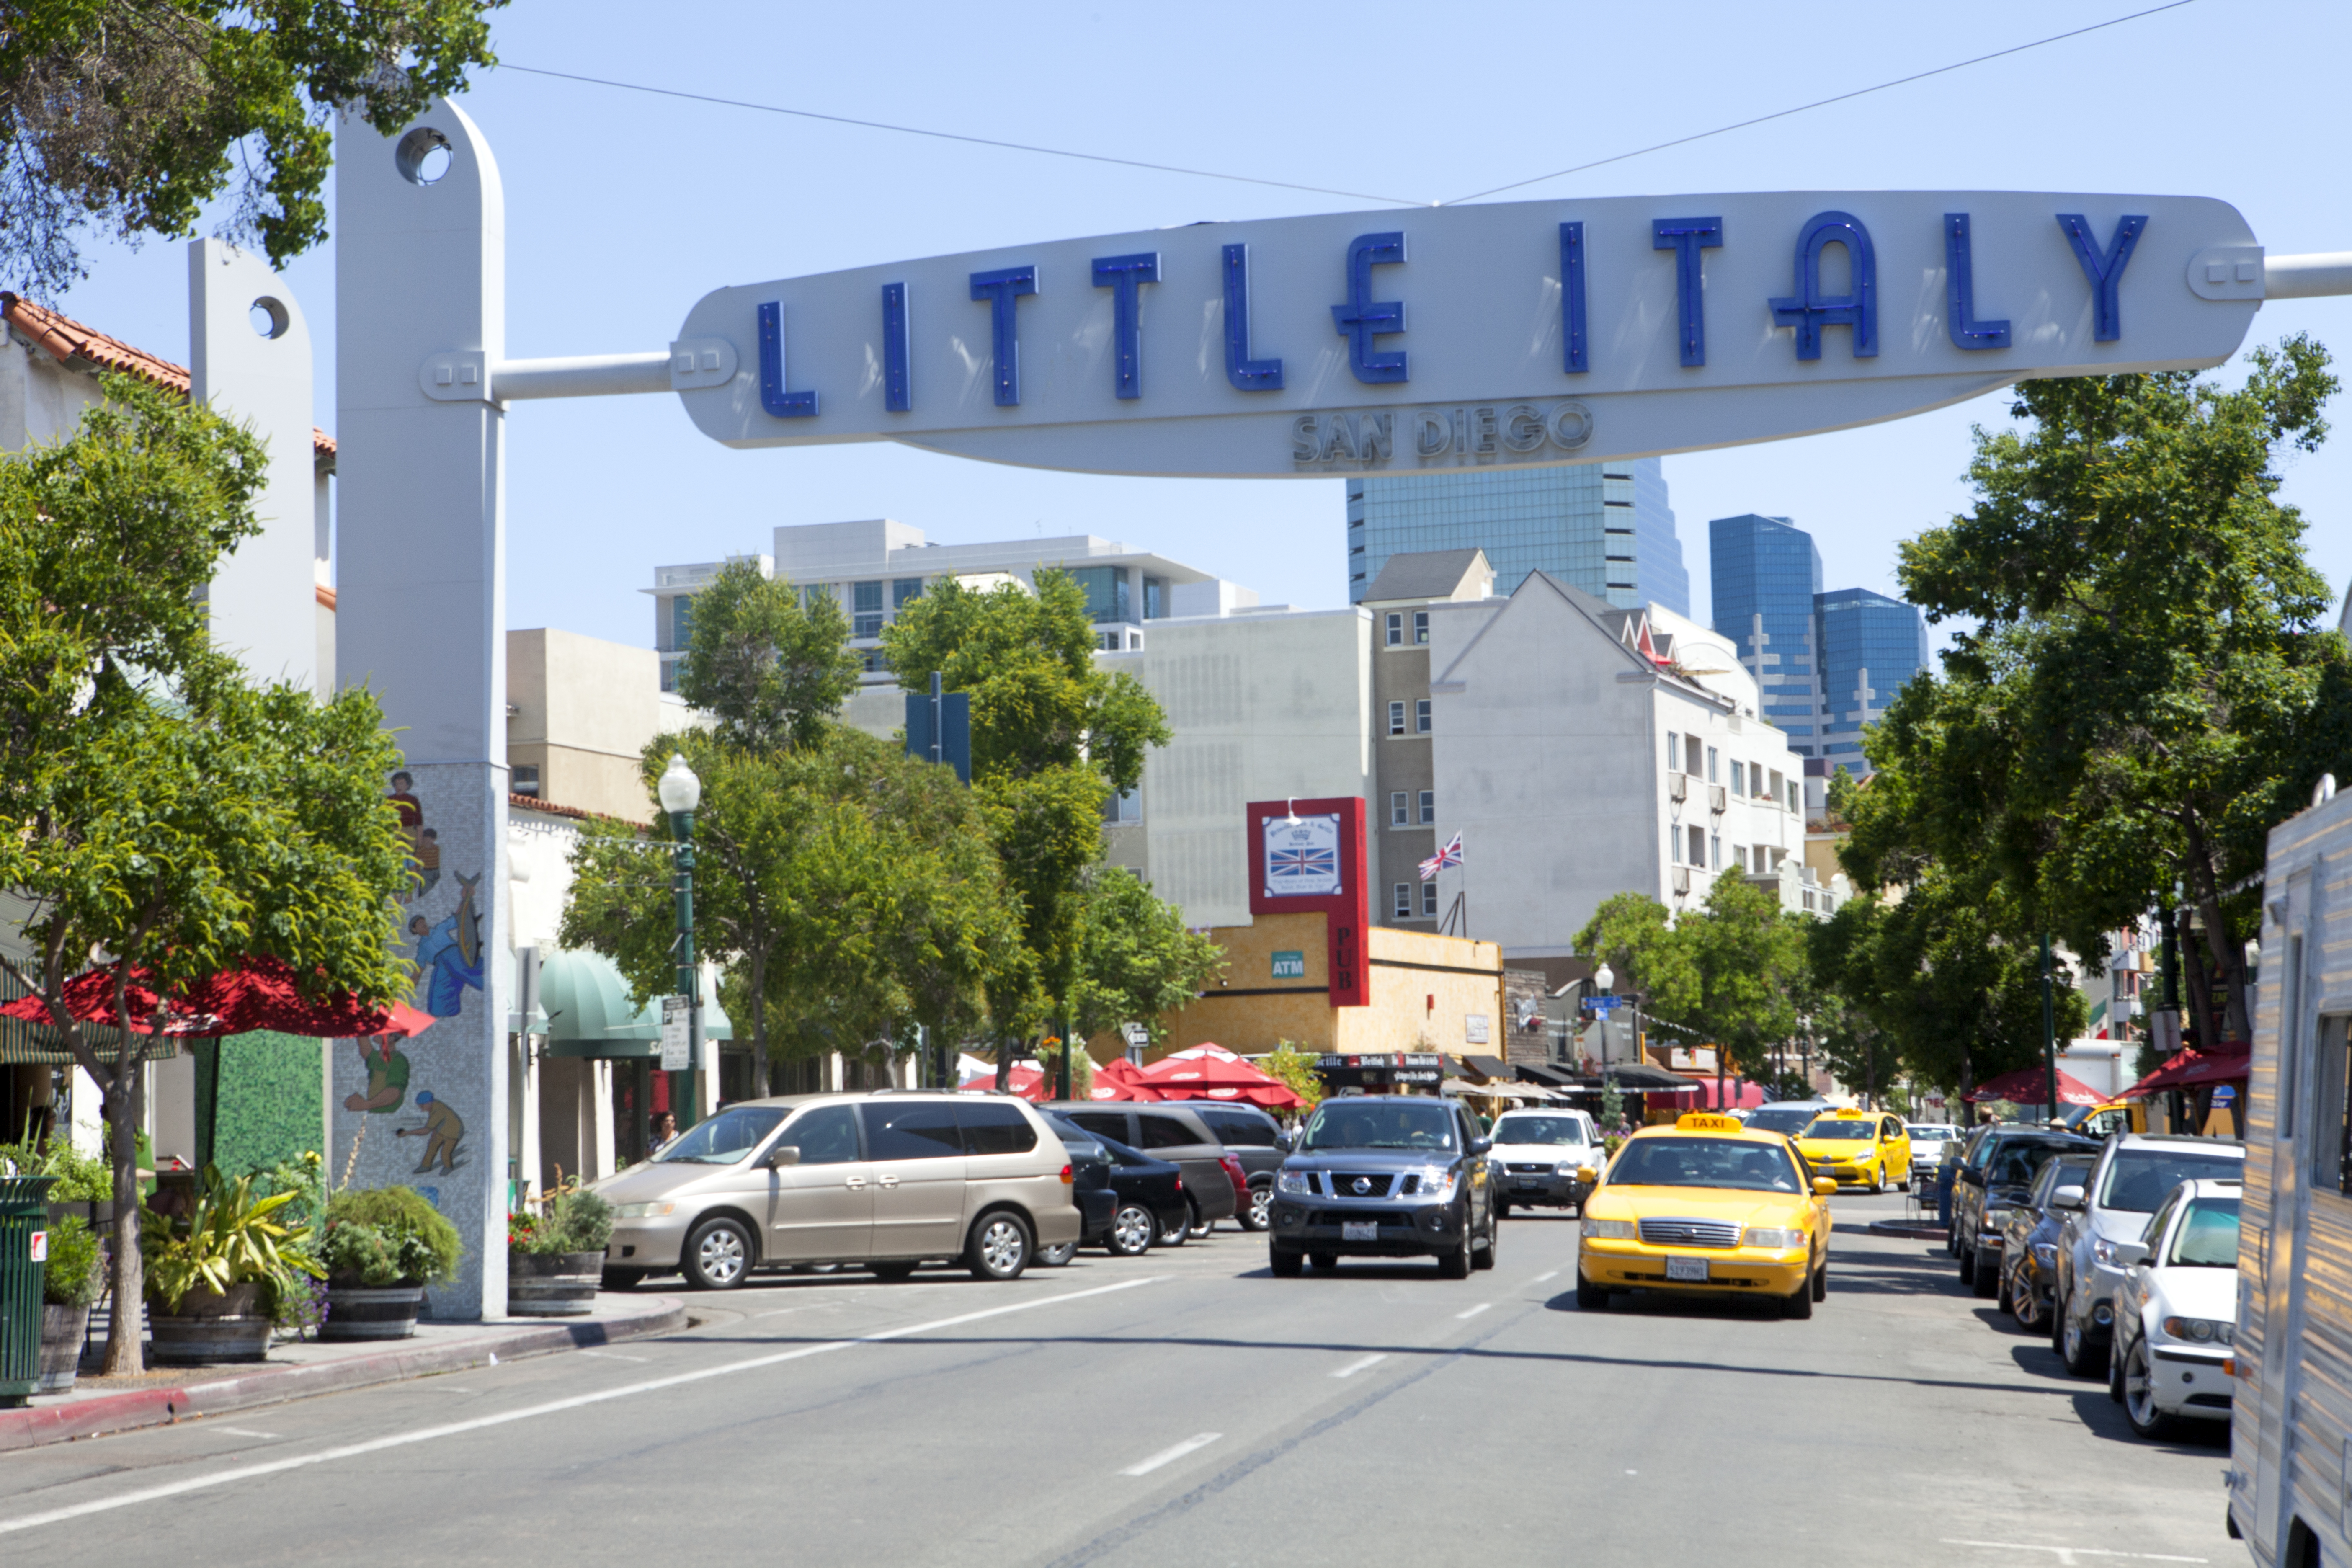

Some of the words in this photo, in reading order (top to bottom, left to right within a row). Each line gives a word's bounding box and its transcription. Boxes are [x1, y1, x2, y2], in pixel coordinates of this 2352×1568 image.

[758, 231, 1409, 418] LITTLE
[1560, 211, 2149, 373] ITALY
[1292, 413, 1394, 462] SAN
[1416, 402, 1594, 456] DIEGO
[1273, 960, 1303, 975] ATM
[1337, 927, 1352, 990] PUB
[1691, 1117, 1725, 1128] TAXI
